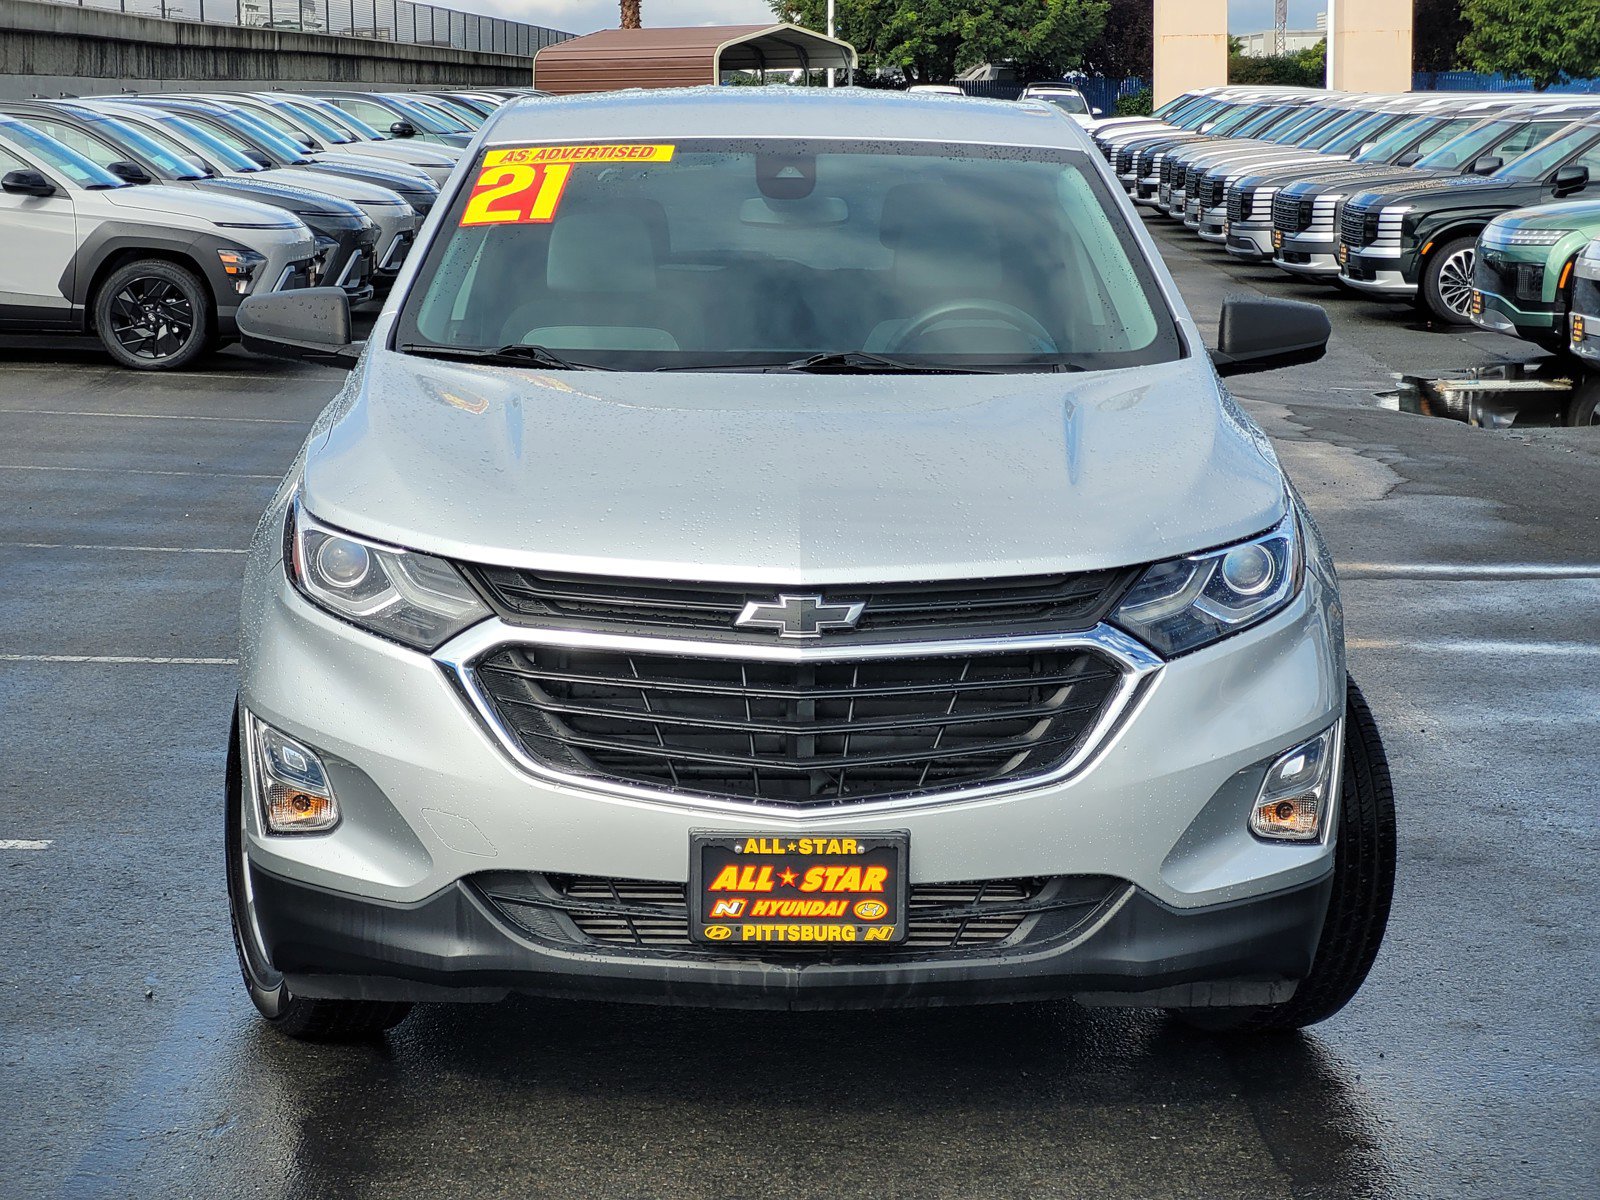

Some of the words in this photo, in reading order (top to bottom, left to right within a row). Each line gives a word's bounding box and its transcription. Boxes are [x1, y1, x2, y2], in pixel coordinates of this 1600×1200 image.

[500, 149, 530, 163] AS
[532, 146, 656, 161] ADVERTISED
[462, 164, 571, 224] 21
[743, 838, 785, 854] ALL
[798, 838, 857, 855] STAR
[708, 865, 774, 892] ALL
[799, 865, 888, 893] STAR
[750, 900, 850, 917] HYUNDAI
[742, 925, 856, 941] PITTSBURG
